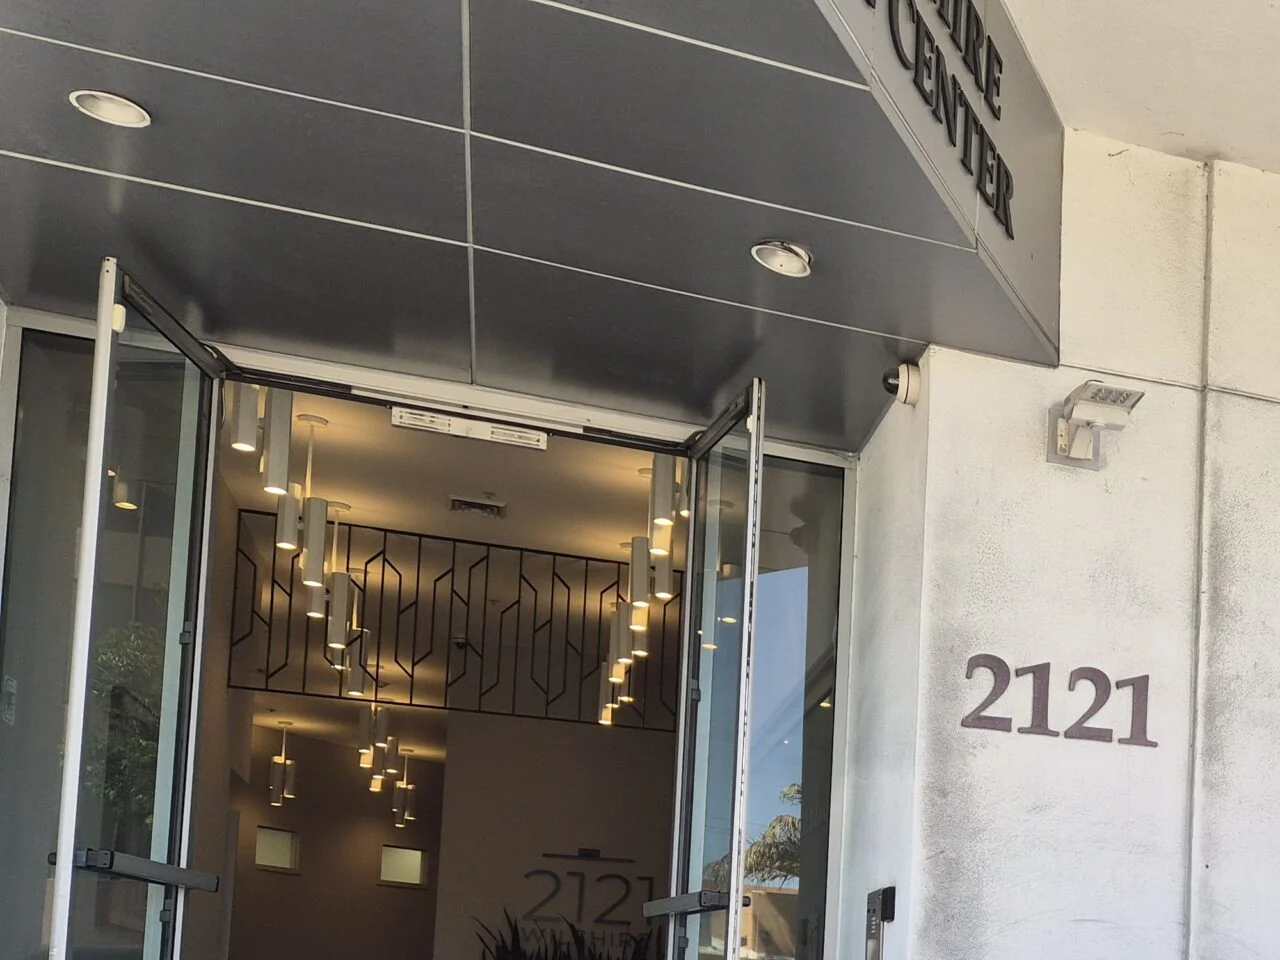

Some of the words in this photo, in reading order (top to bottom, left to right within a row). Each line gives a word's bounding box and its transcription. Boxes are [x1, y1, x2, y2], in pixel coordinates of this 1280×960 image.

[932, 0, 1003, 121] IRE
[889, 0, 1015, 240] CENTER
[961, 653, 1158, 748] 2121
[523, 868, 655, 927] 2121
